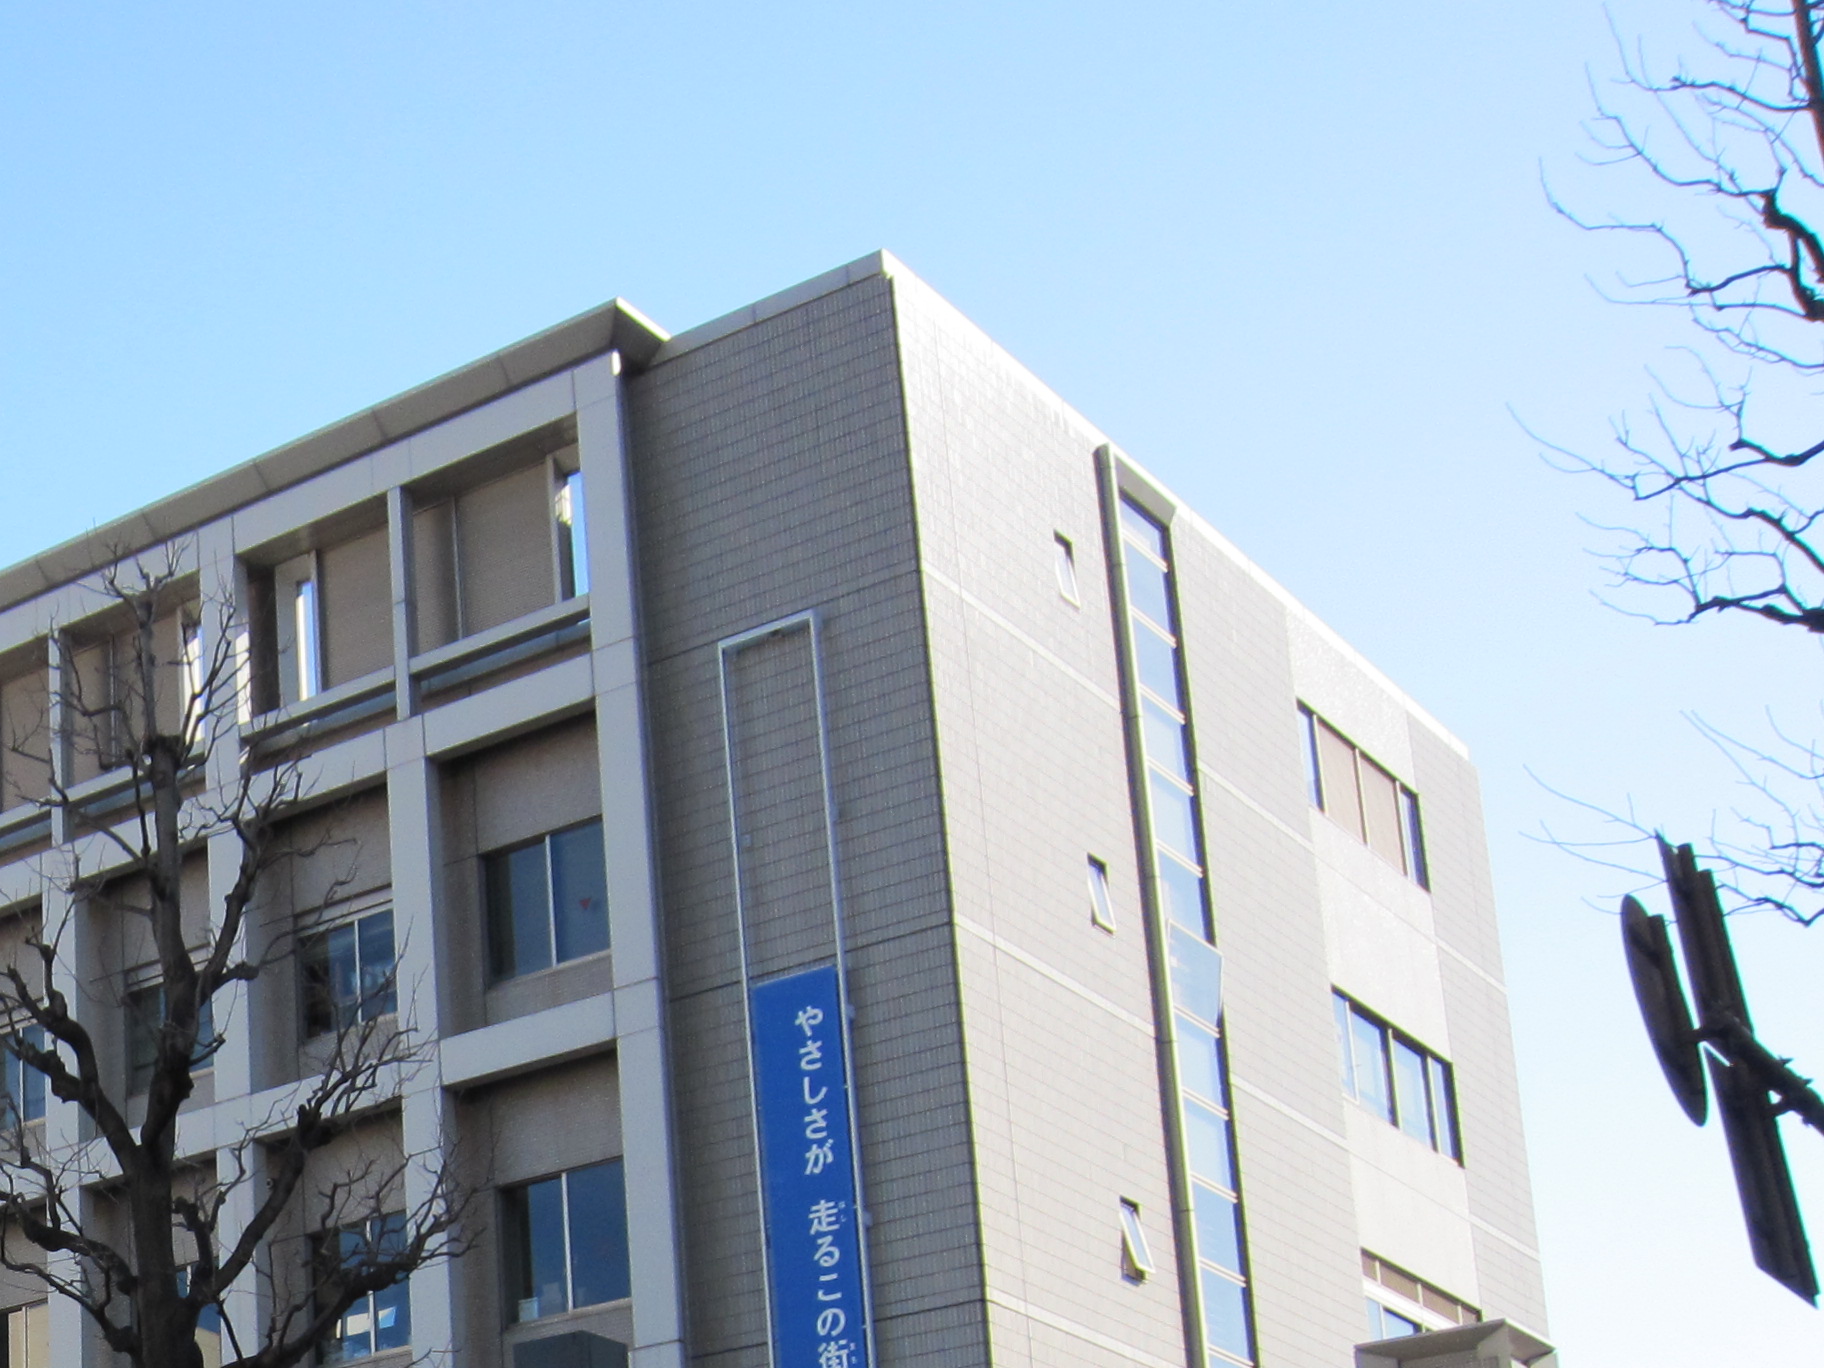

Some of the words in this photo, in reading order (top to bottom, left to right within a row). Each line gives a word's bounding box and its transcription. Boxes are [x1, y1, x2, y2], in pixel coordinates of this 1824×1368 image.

[794, 1005, 834, 1175] やさしさが
